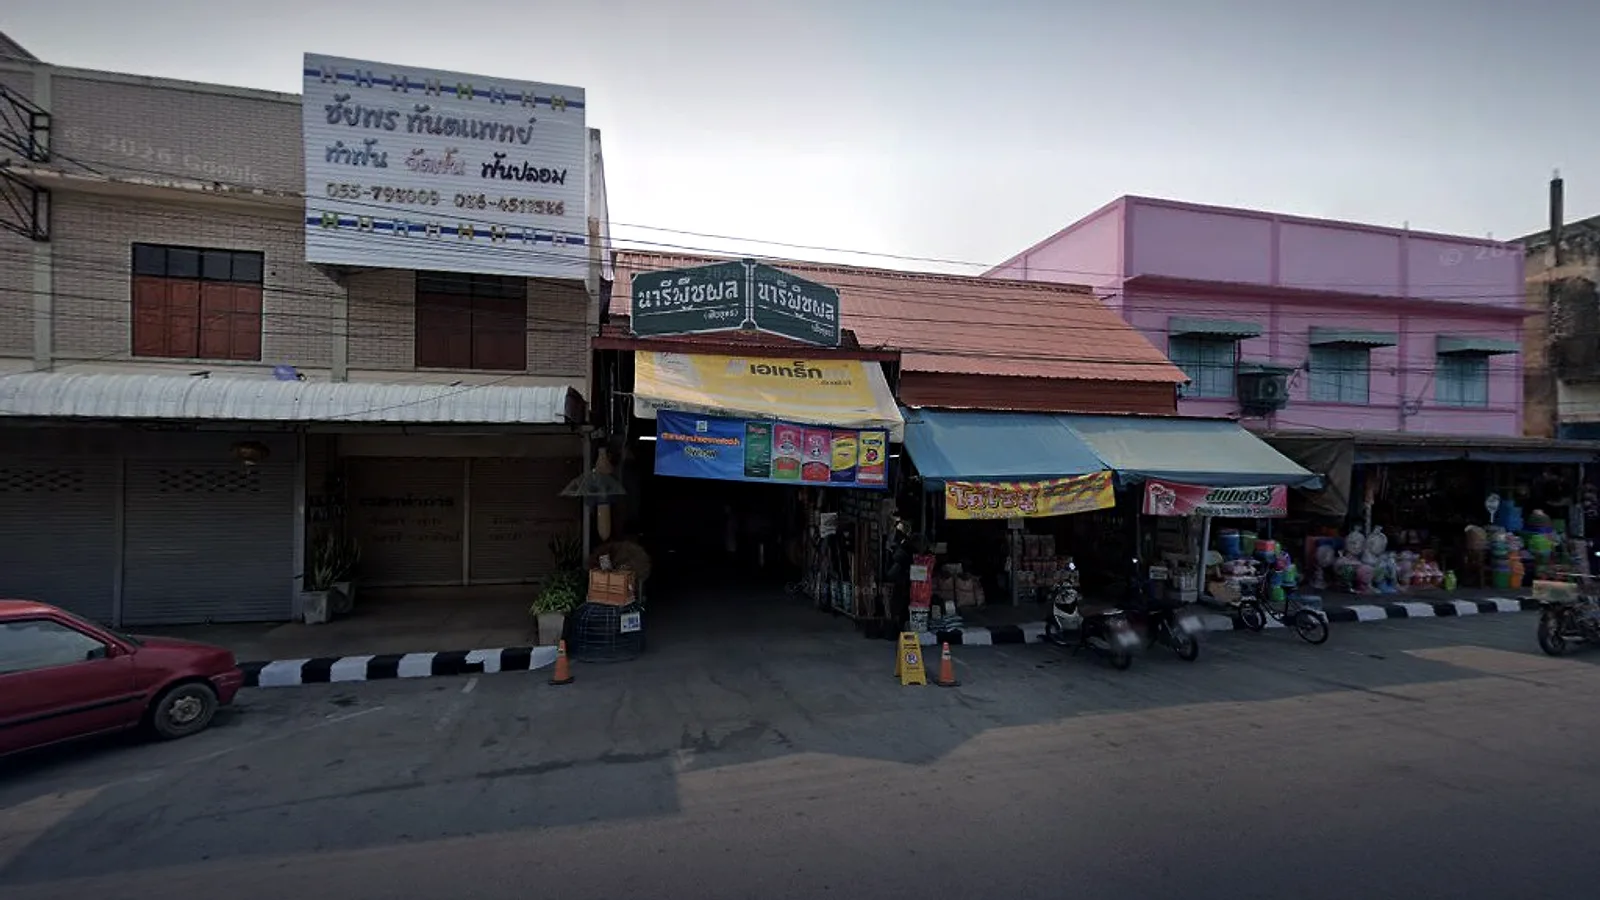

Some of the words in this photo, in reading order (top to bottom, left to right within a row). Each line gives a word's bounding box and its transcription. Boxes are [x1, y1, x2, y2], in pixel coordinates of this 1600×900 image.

[325, 93, 400, 132] ชัยพร
[406, 104, 537, 145] ทันตแพทย์
[325, 138, 388, 168] ทำฟัน
[481, 152, 567, 185] ฟันปลอม
[638, 277, 739, 308] นารีพืชผล
[757, 279, 835, 322] นารีพืชผล
[750, 360, 823, 379] เอเทร็ก
